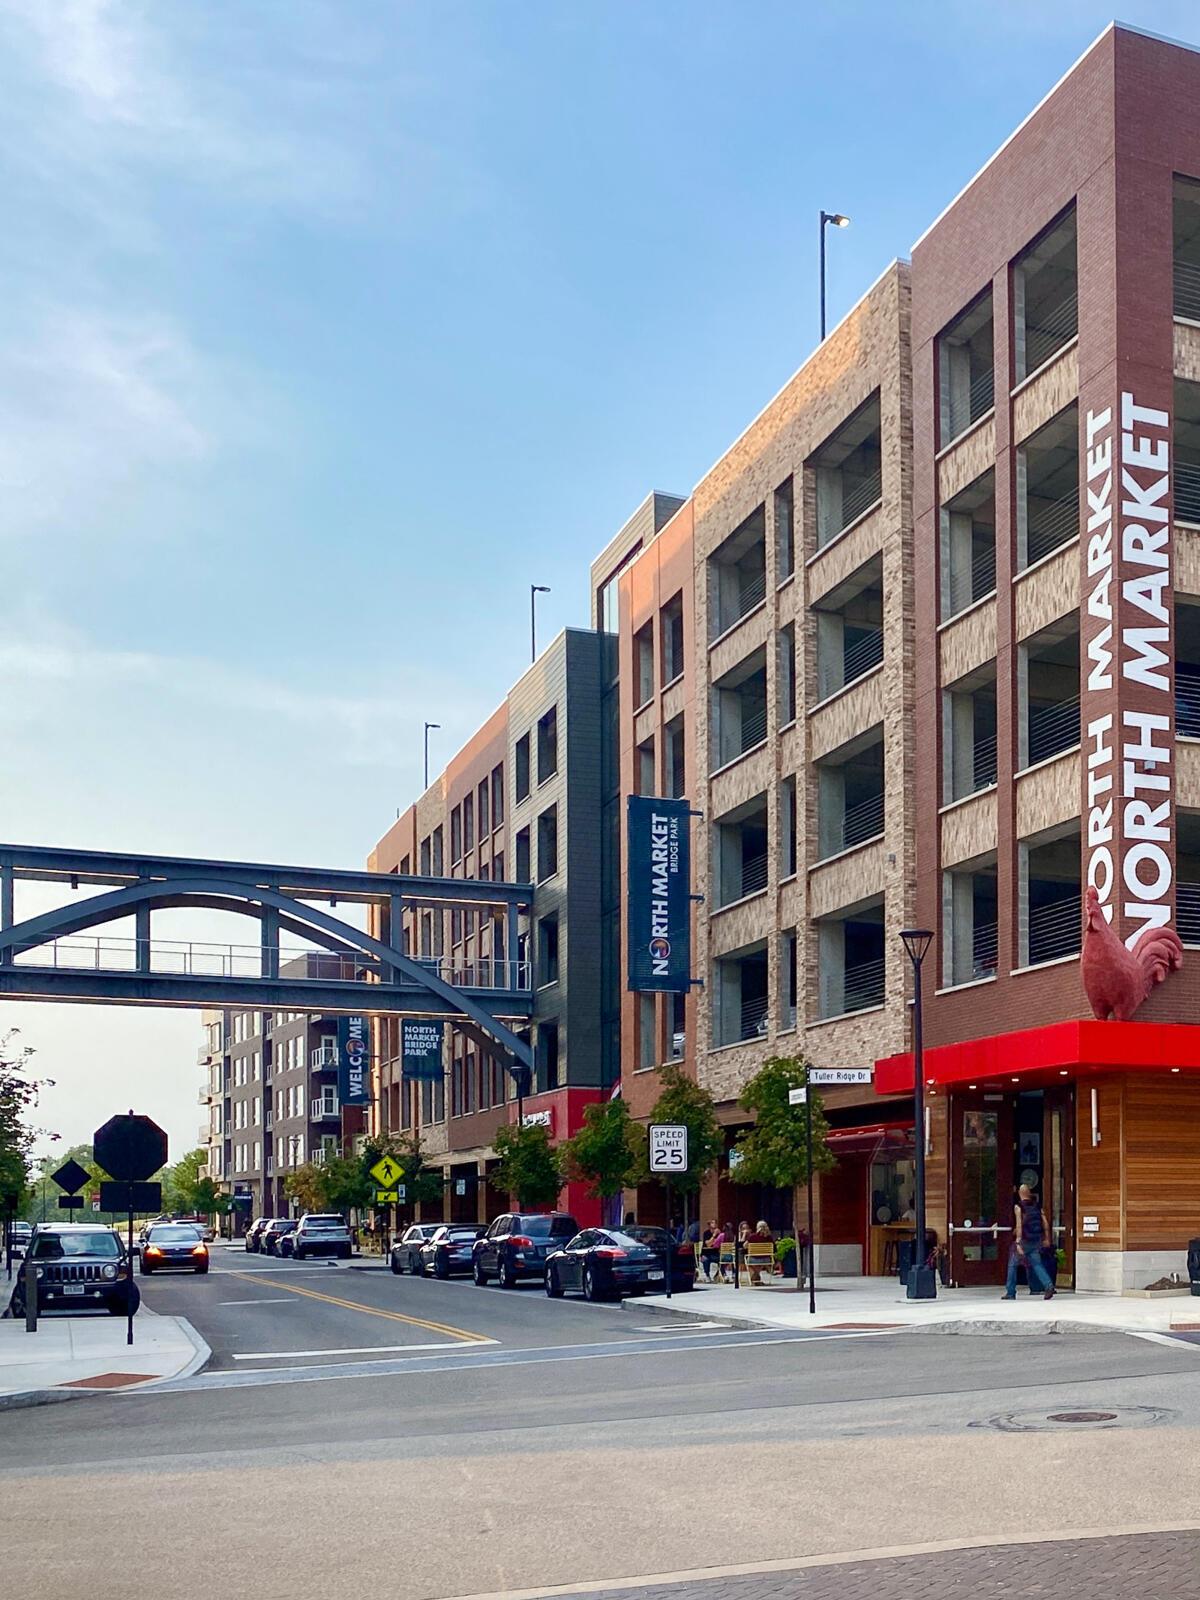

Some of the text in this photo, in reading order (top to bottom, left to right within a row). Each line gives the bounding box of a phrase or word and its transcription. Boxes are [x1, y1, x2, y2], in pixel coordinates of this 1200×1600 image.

[1121, 391, 1170, 692] MARKET
[1086, 406, 1113, 925] ORTH MARKET
[670, 817, 679, 873] BRIDGE PARK
[650, 813, 671, 976] NORTH MARKET
[404, 1026, 436, 1034] NORTH
[404, 1041, 438, 1049] BRIDGE
[404, 1048, 428, 1056] PARK
[346, 1017, 365, 1097] WELCOME
[814, 1072, 866, 1082] Tuller Ridge Dr
[654, 1131, 684, 1139] SPEED
[655, 1149, 683, 1165] 25
